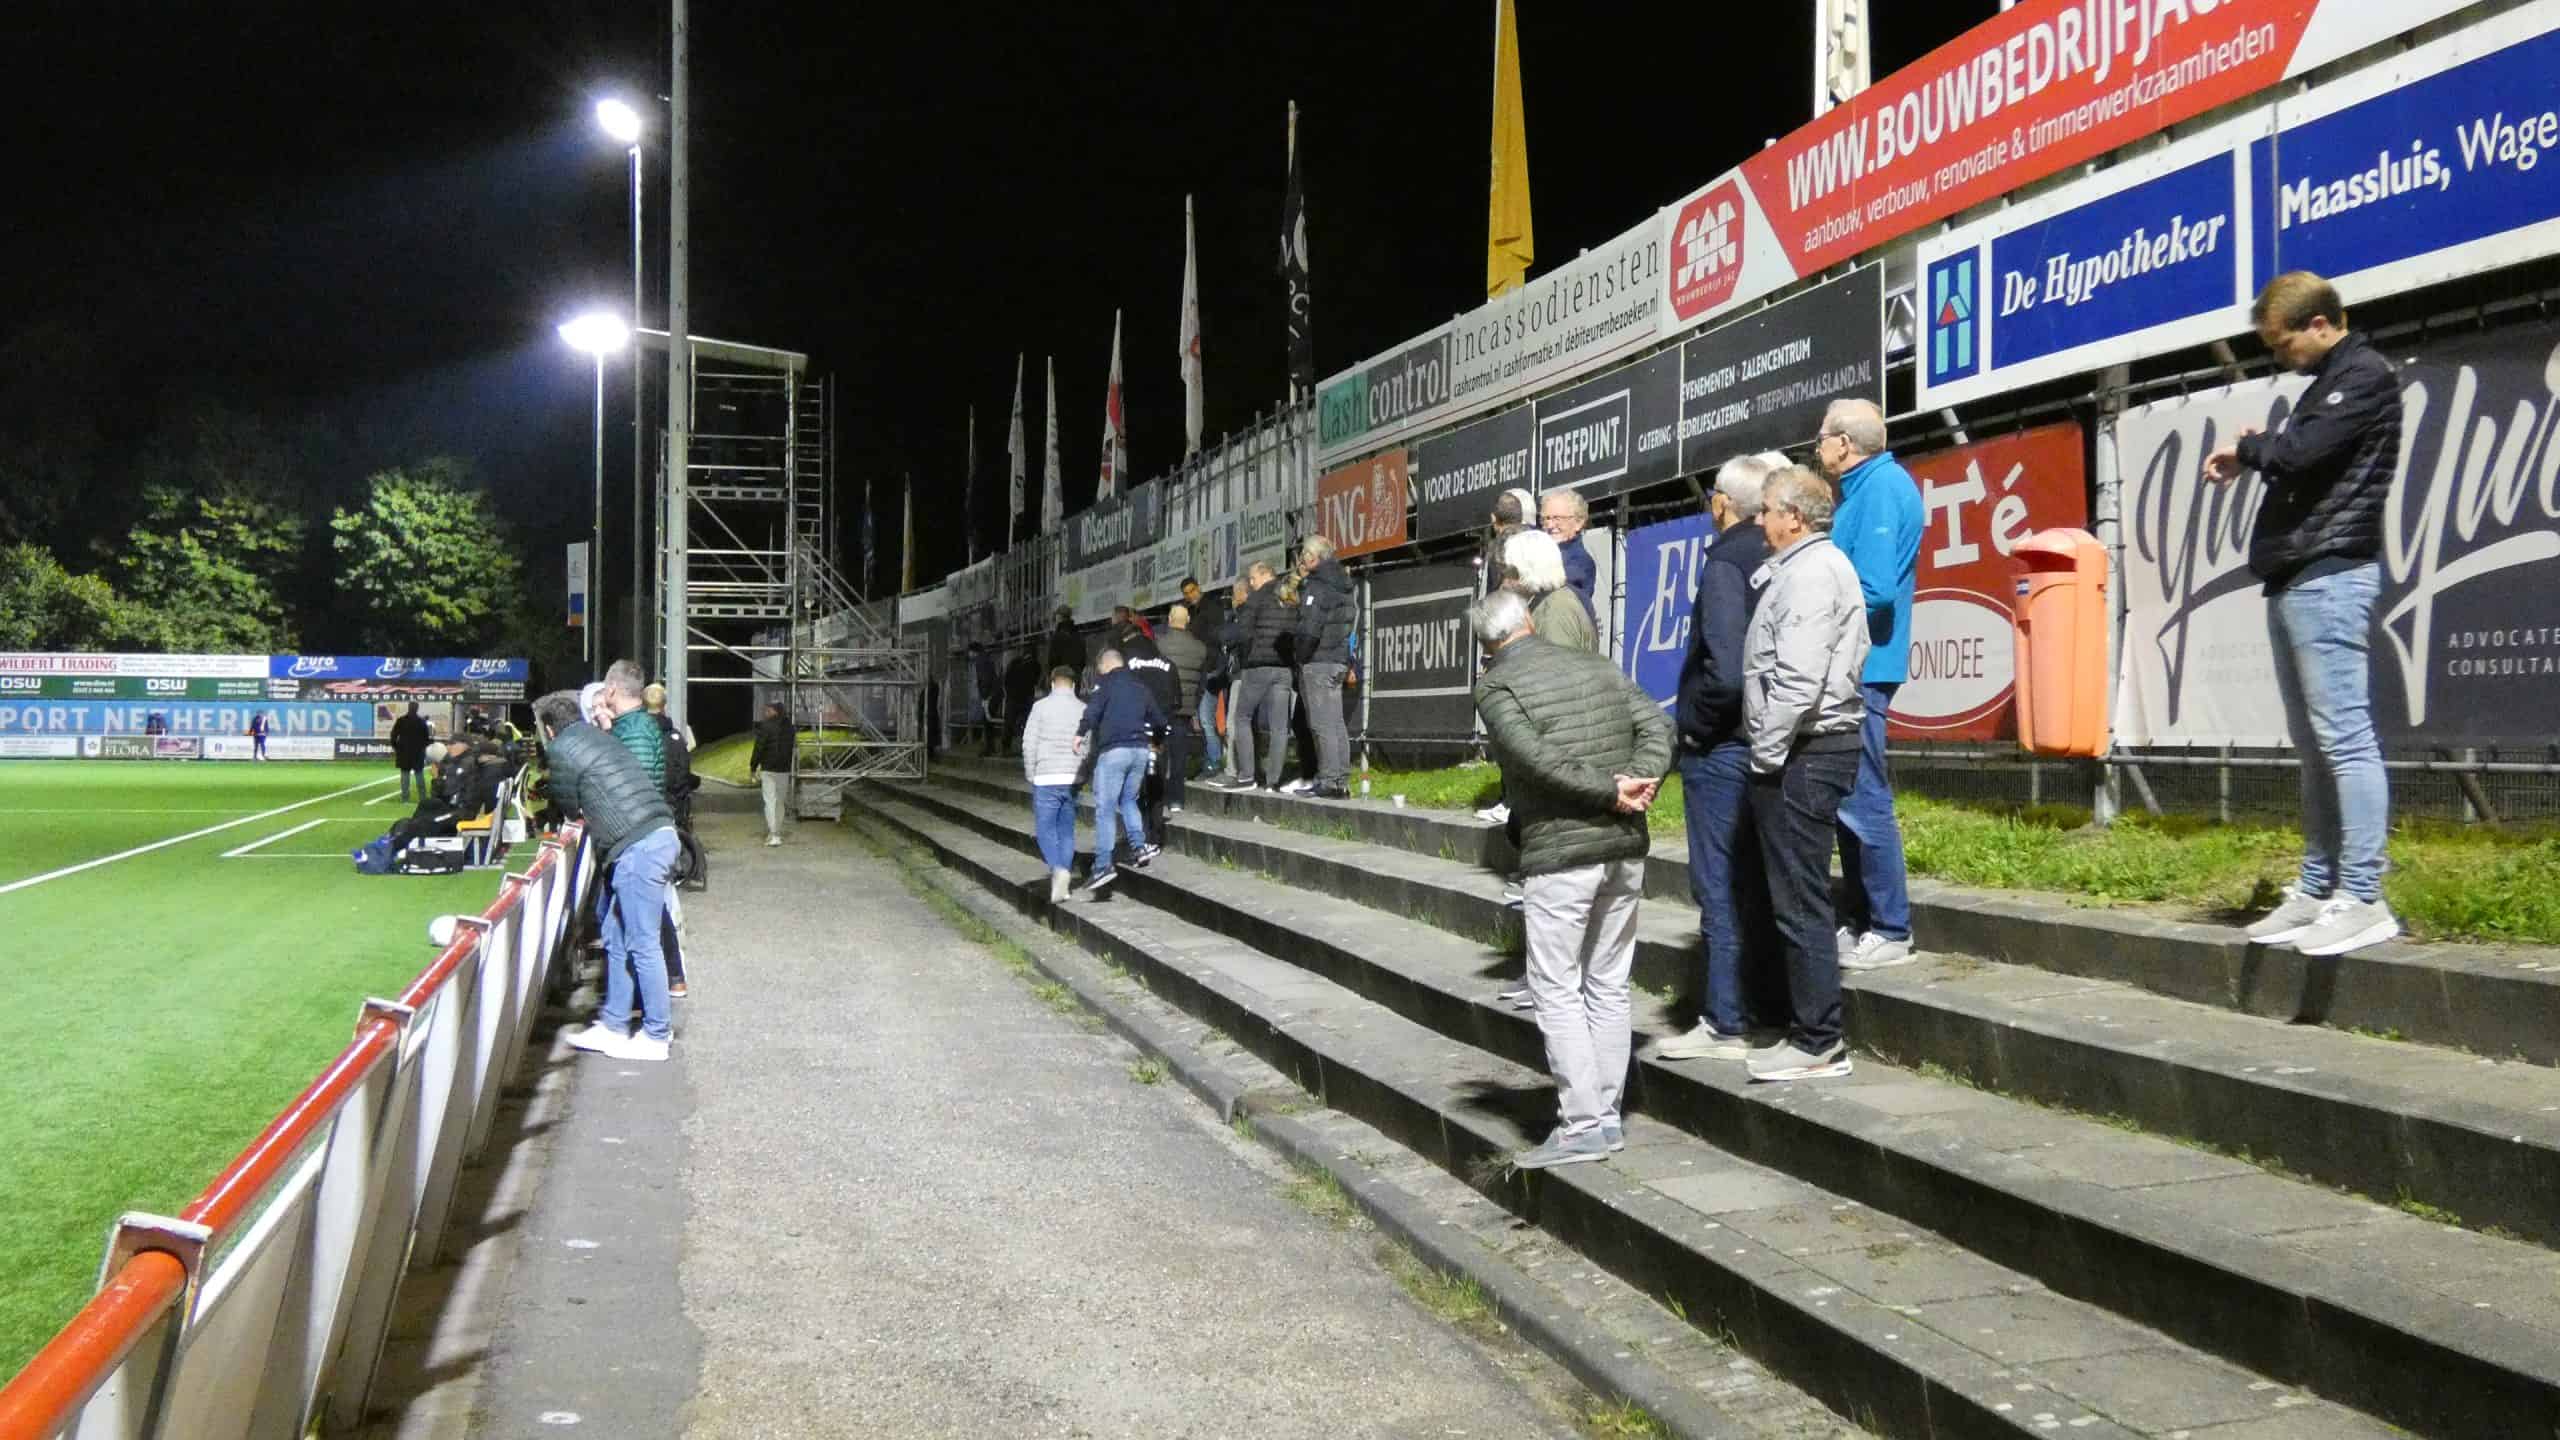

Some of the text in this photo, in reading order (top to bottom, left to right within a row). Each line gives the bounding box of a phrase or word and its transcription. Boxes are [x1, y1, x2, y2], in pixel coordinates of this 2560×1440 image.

[1787, 0, 2232, 212] WWW.BOUWBEDRIJFJ
[1804, 23, 2275, 253] aanbouw, verbouw, renovatie & timmerwerkzaamheden
[2279, 139, 2451, 230] Maassluis,
[1455, 239, 1659, 366] incassodiensten
[2000, 213, 2227, 317] De Hypotheker
[1320, 335, 1451, 443] Cash control
[1638, 424, 1672, 452] CATERING
[1755, 359, 1872, 416] TREFPUNTMAASLAND.NL
[1680, 336, 1812, 402] EVENEMENTEN ZALENCENTRUM
[1322, 485, 1367, 548] ING
[1424, 448, 1528, 504] VOOR DE DERDE HELFT
[60, 656, 117, 671] TRADING
